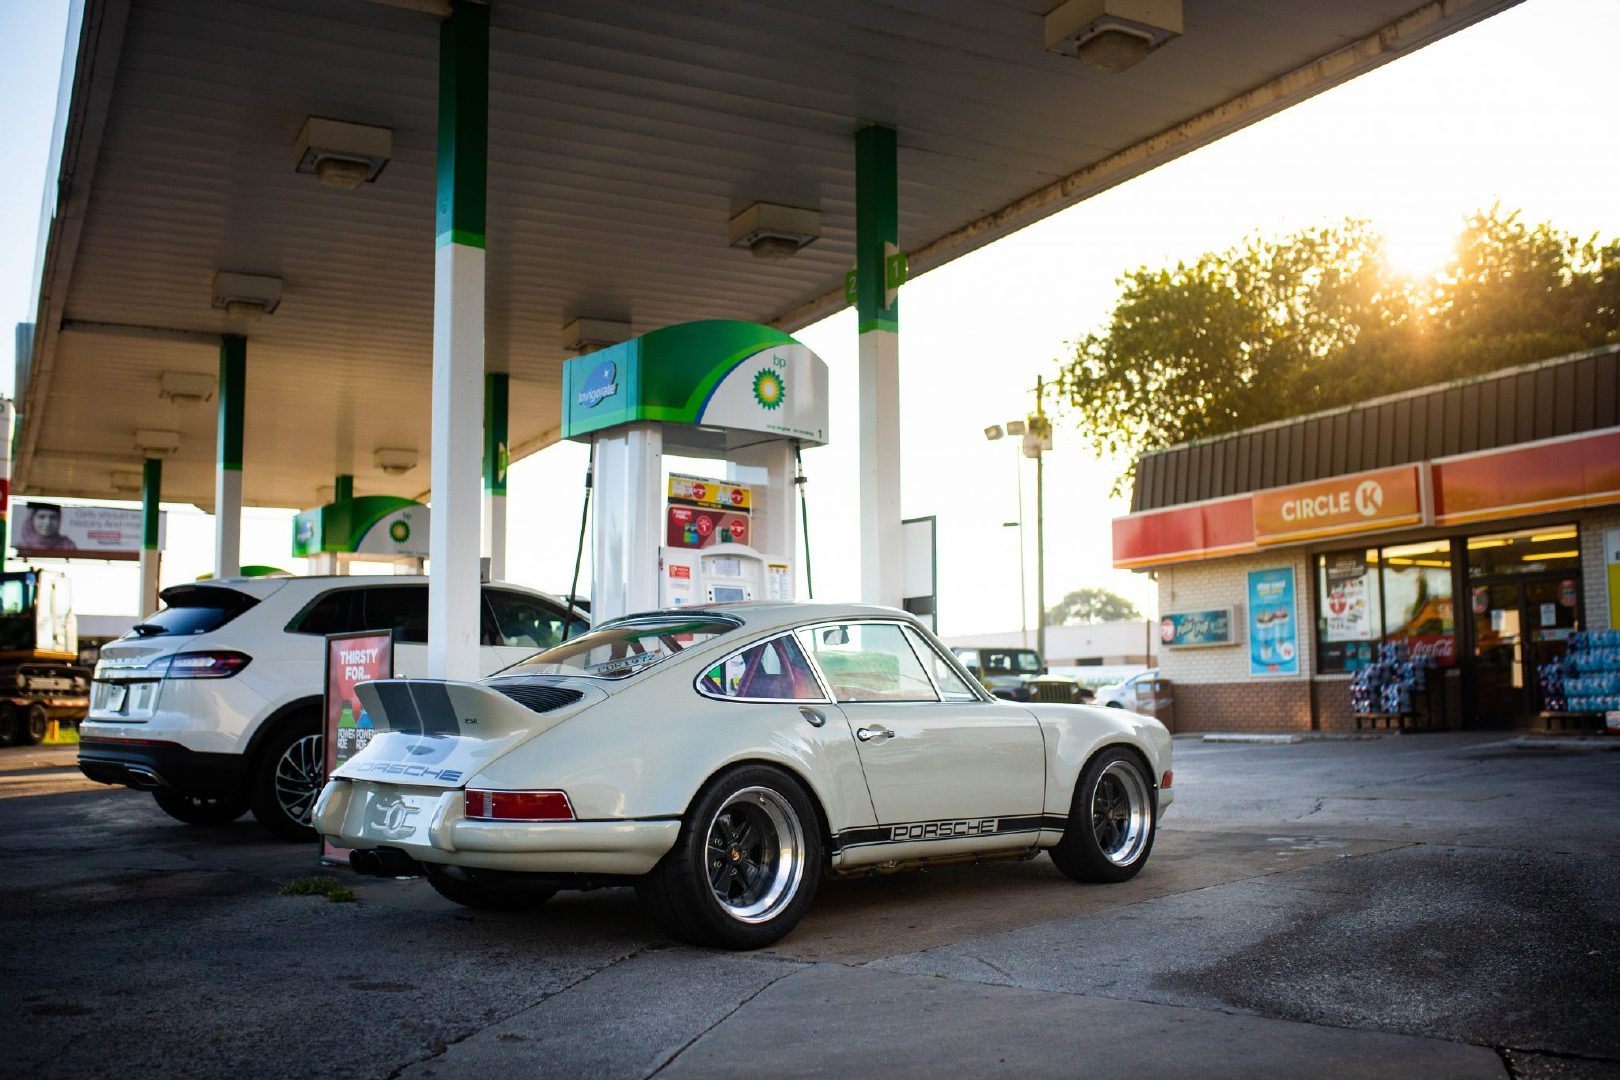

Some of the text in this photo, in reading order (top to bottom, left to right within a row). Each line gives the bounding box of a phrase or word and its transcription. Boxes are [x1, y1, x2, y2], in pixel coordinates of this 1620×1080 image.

[892, 261, 899, 279] 1
[848, 276, 857, 294] 2
[773, 353, 786, 368] bp
[578, 384, 616, 403] Invigorate
[818, 428, 822, 439] 1
[1281, 482, 1383, 522] CIRCLE K
[340, 648, 378, 665] THIRSTY
[345, 666, 371, 680] FOR...
[346, 762, 464, 782] PORSCHE
[893, 820, 995, 840] PORSCHE
